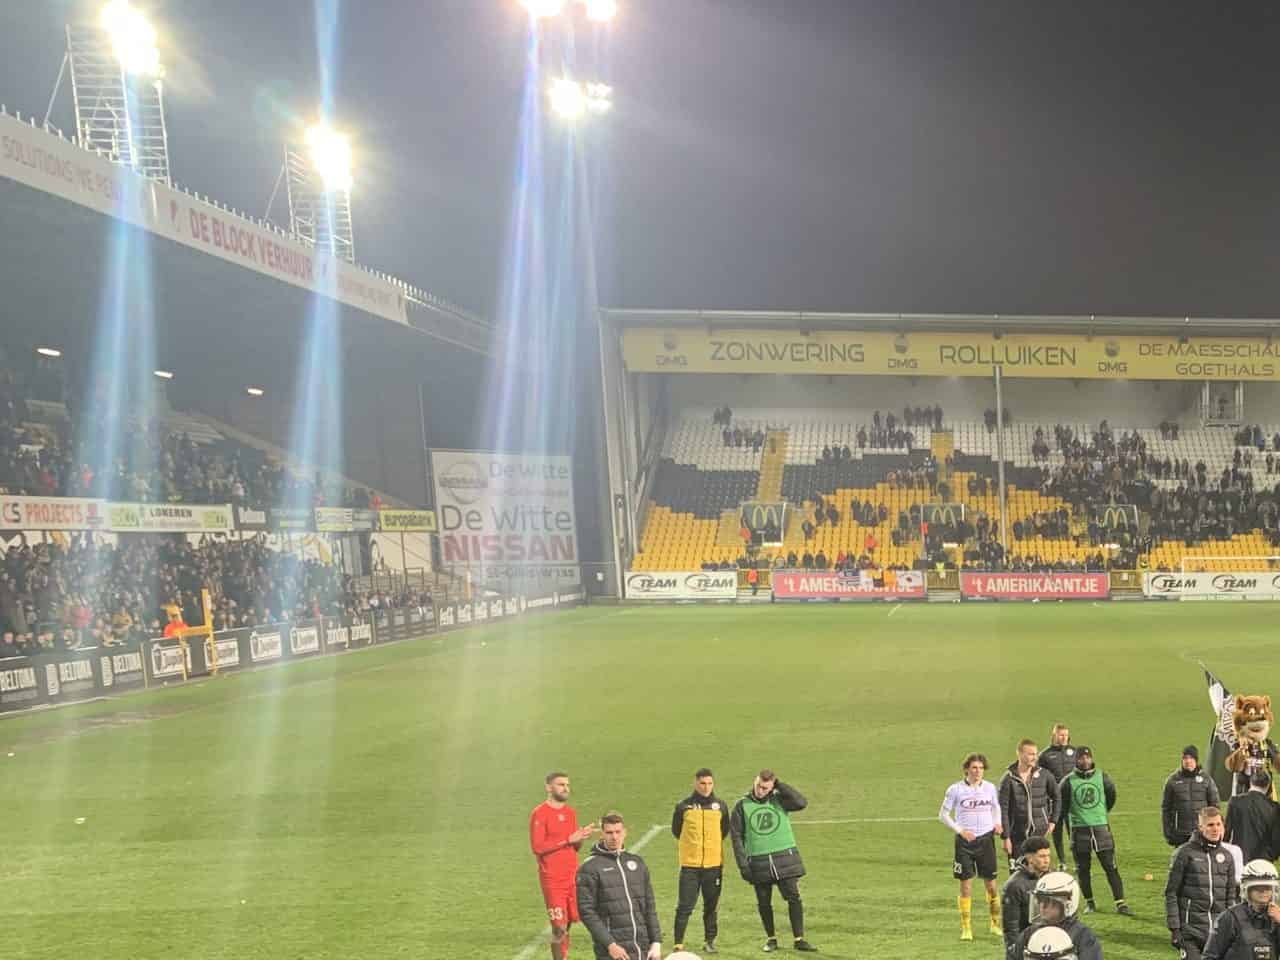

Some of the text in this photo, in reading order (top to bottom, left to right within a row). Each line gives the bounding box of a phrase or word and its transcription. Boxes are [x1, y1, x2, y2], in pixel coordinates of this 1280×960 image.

[189, 207, 314, 281] DE BLOCK VERHUUR
[709, 341, 865, 362] ZONWERING
[939, 344, 1077, 366] ROLLUIKEN
[1138, 343, 1163, 356] DE
[887, 358, 919, 369] DMG
[1098, 361, 1128, 373] DMG
[1175, 362, 1275, 377] GOETHALS
[25, 503, 84, 523] PROJECTS
[150, 507, 193, 519] LOKEREN
[440, 504, 572, 531] De Witte
[443, 535, 576, 561] NISSAN
[798, 577, 915, 593] AMERKAAJ
[986, 577, 1099, 593] AMERIKAANTJE
[547, 906, 564, 921] 33
